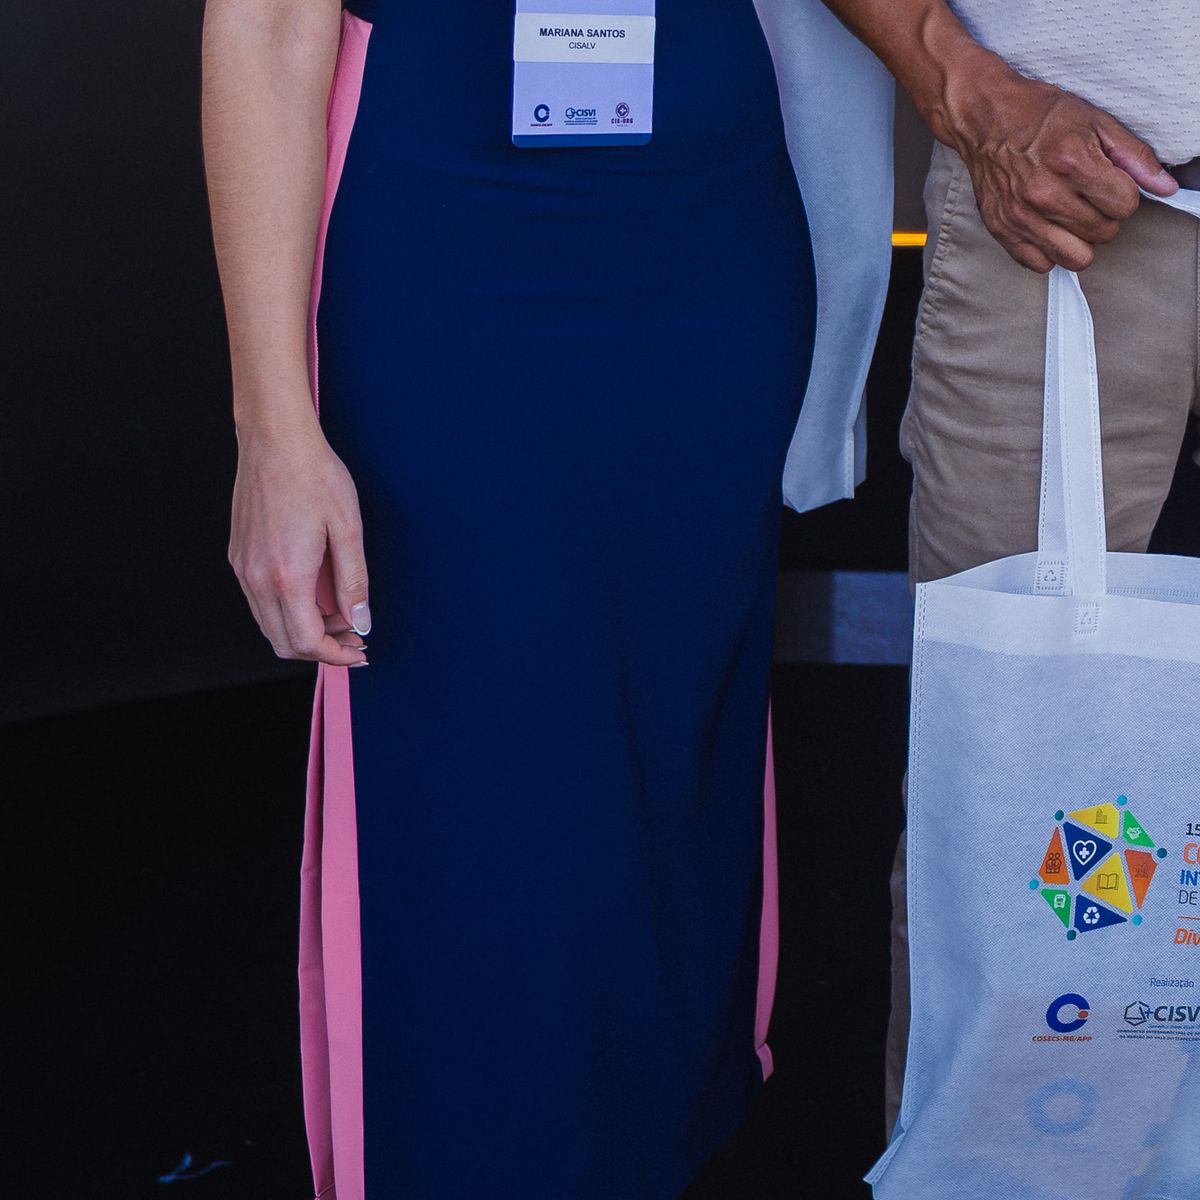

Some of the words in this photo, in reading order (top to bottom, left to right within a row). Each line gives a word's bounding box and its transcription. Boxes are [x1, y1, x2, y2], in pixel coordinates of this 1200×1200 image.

[539, 27, 584, 37] MARIANA
[586, 29, 626, 38] SANTOS
[568, 41, 596, 50] CISALV
[1178, 889, 1198, 905] DE
[1150, 976, 1195, 989] Realização
